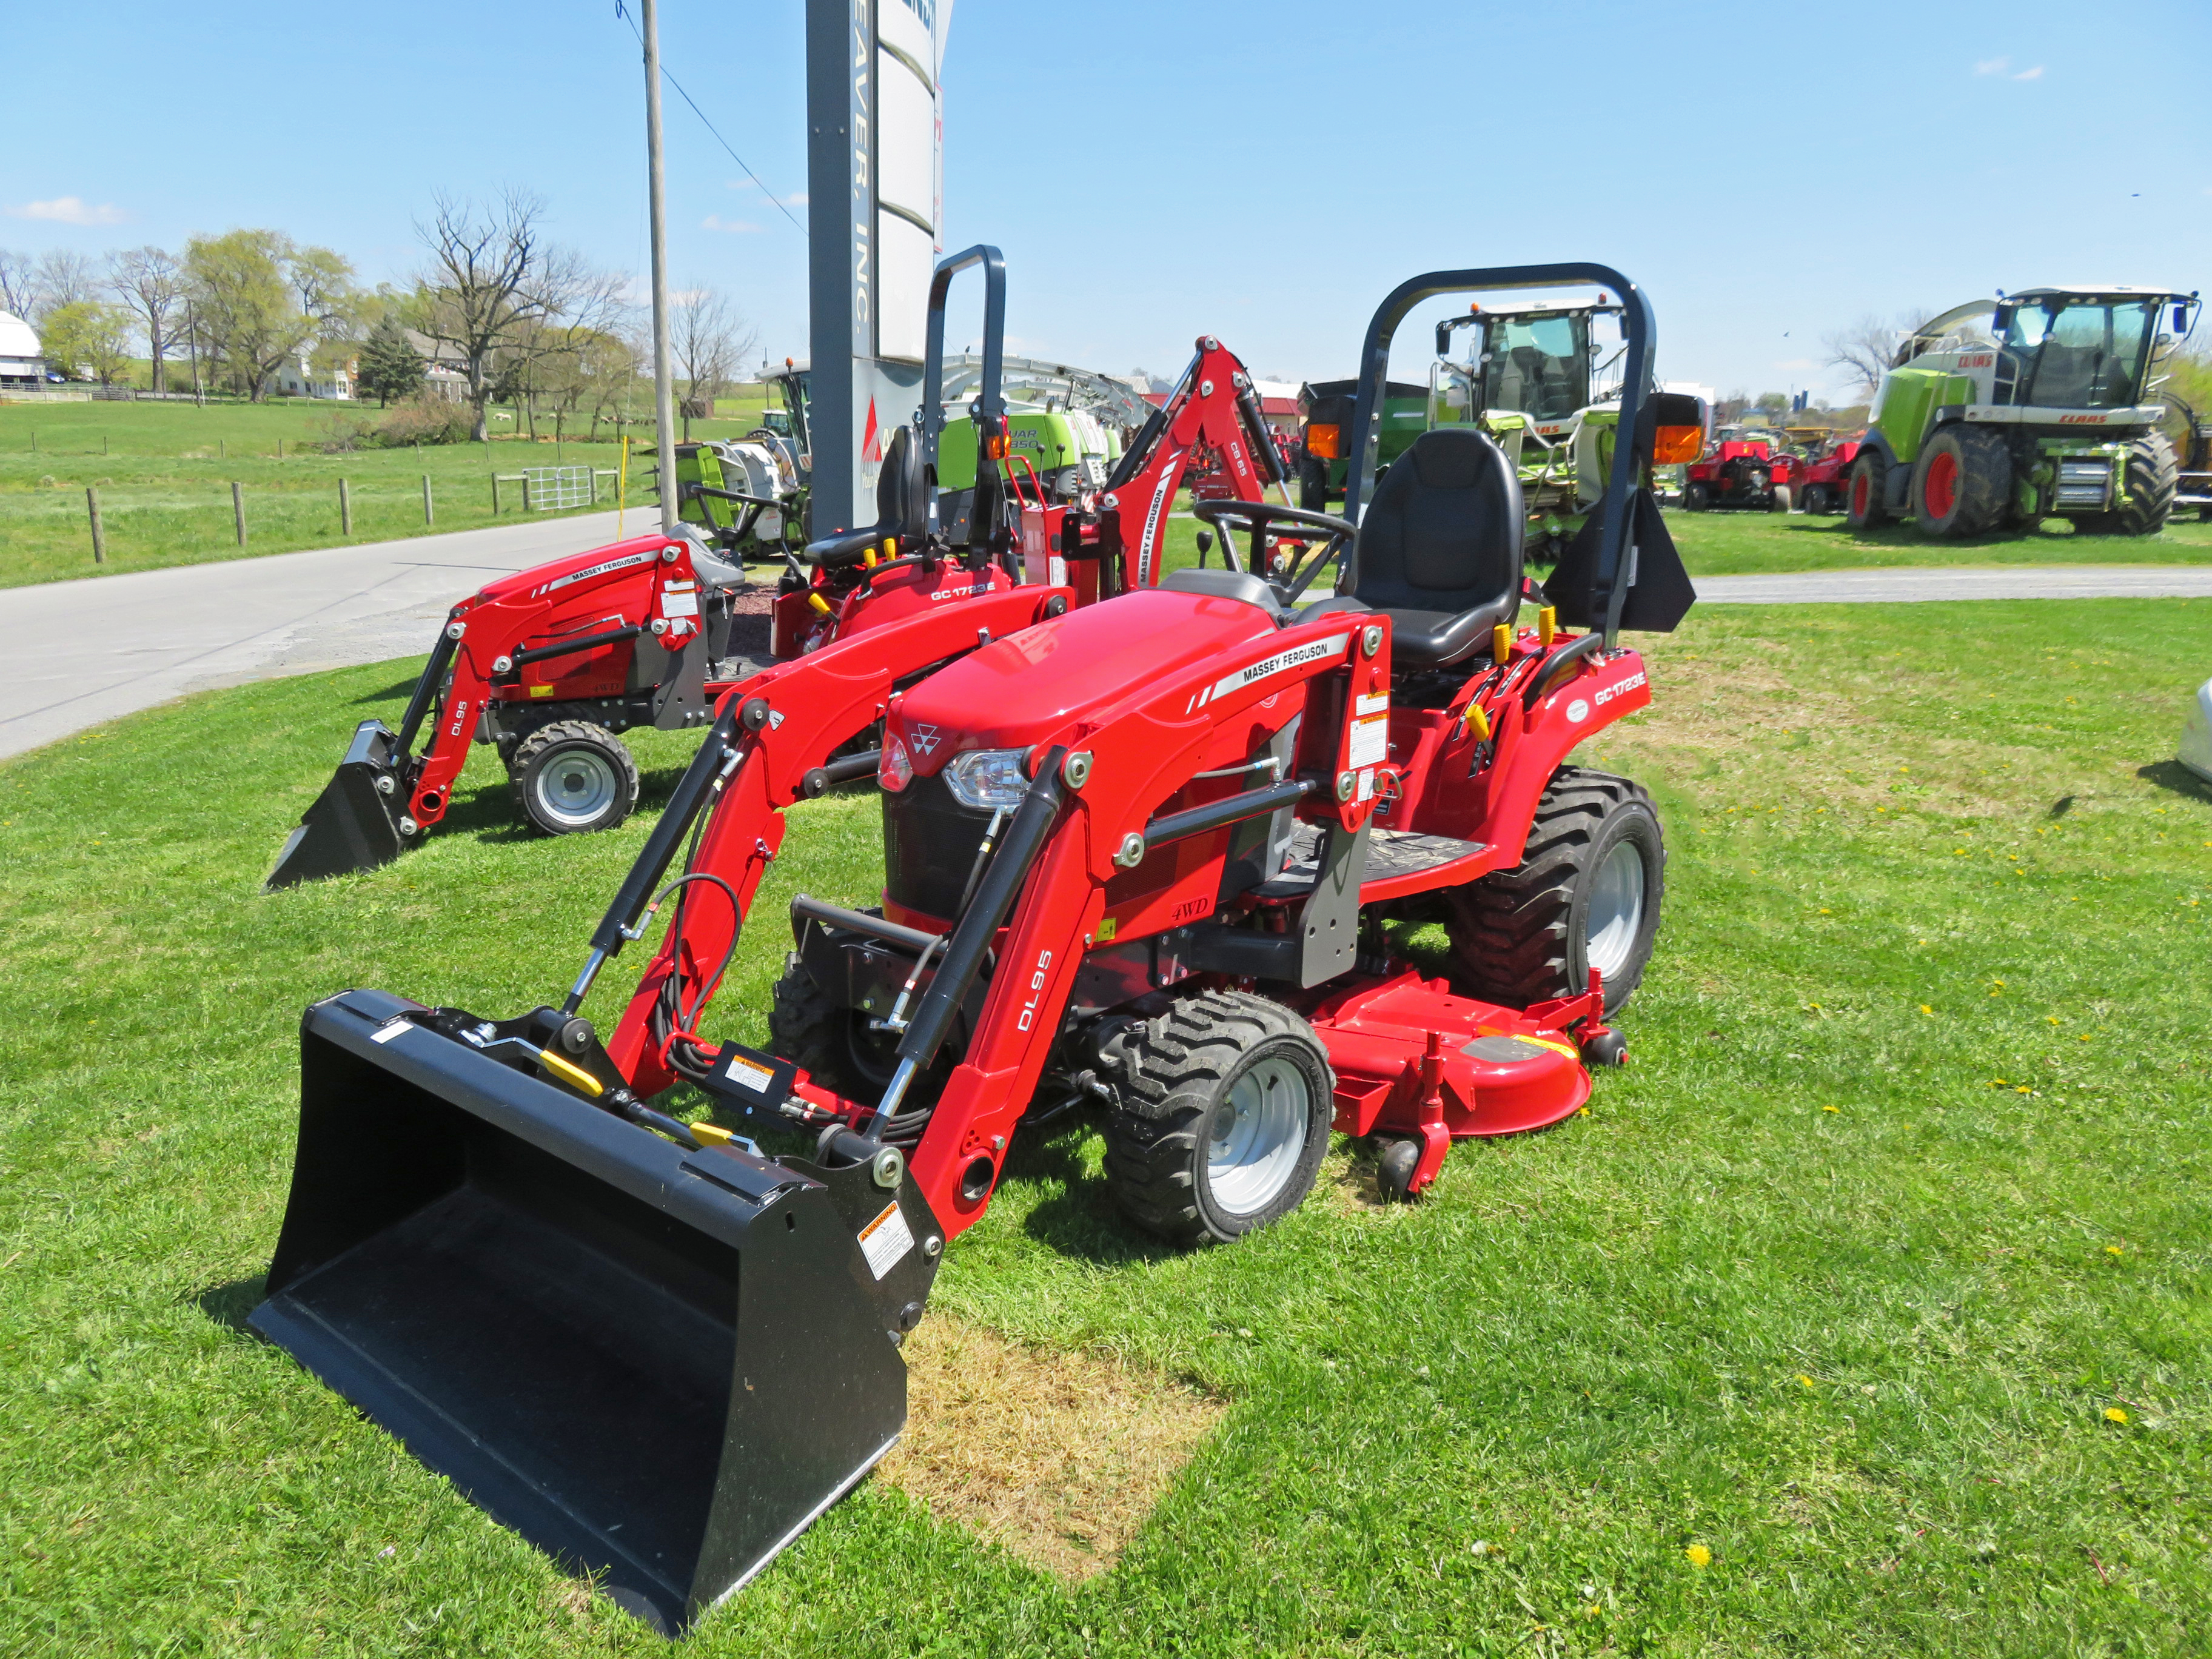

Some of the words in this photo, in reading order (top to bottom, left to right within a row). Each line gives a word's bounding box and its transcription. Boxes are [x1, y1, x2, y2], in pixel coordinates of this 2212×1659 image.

[856, 223, 868, 334] INC.
[1008, 429, 1037, 438] UAR
[2059, 415, 2108, 424] CLAAS
[1145, 489, 1163, 540] FERGUSON
[572, 566, 602, 580] MASSEY
[603, 556, 642, 570] FERGUSON
[1141, 542, 1150, 583] MASSEY
[1244, 657, 1281, 682] MASSEY
[1283, 643, 1327, 666] FERGUSON
[1171, 897, 1208, 921] 4WD
[1017, 950, 1052, 1032] DL95
[745, 1061, 766, 1073] WARNING
[866, 1205, 896, 1234] WARNING
